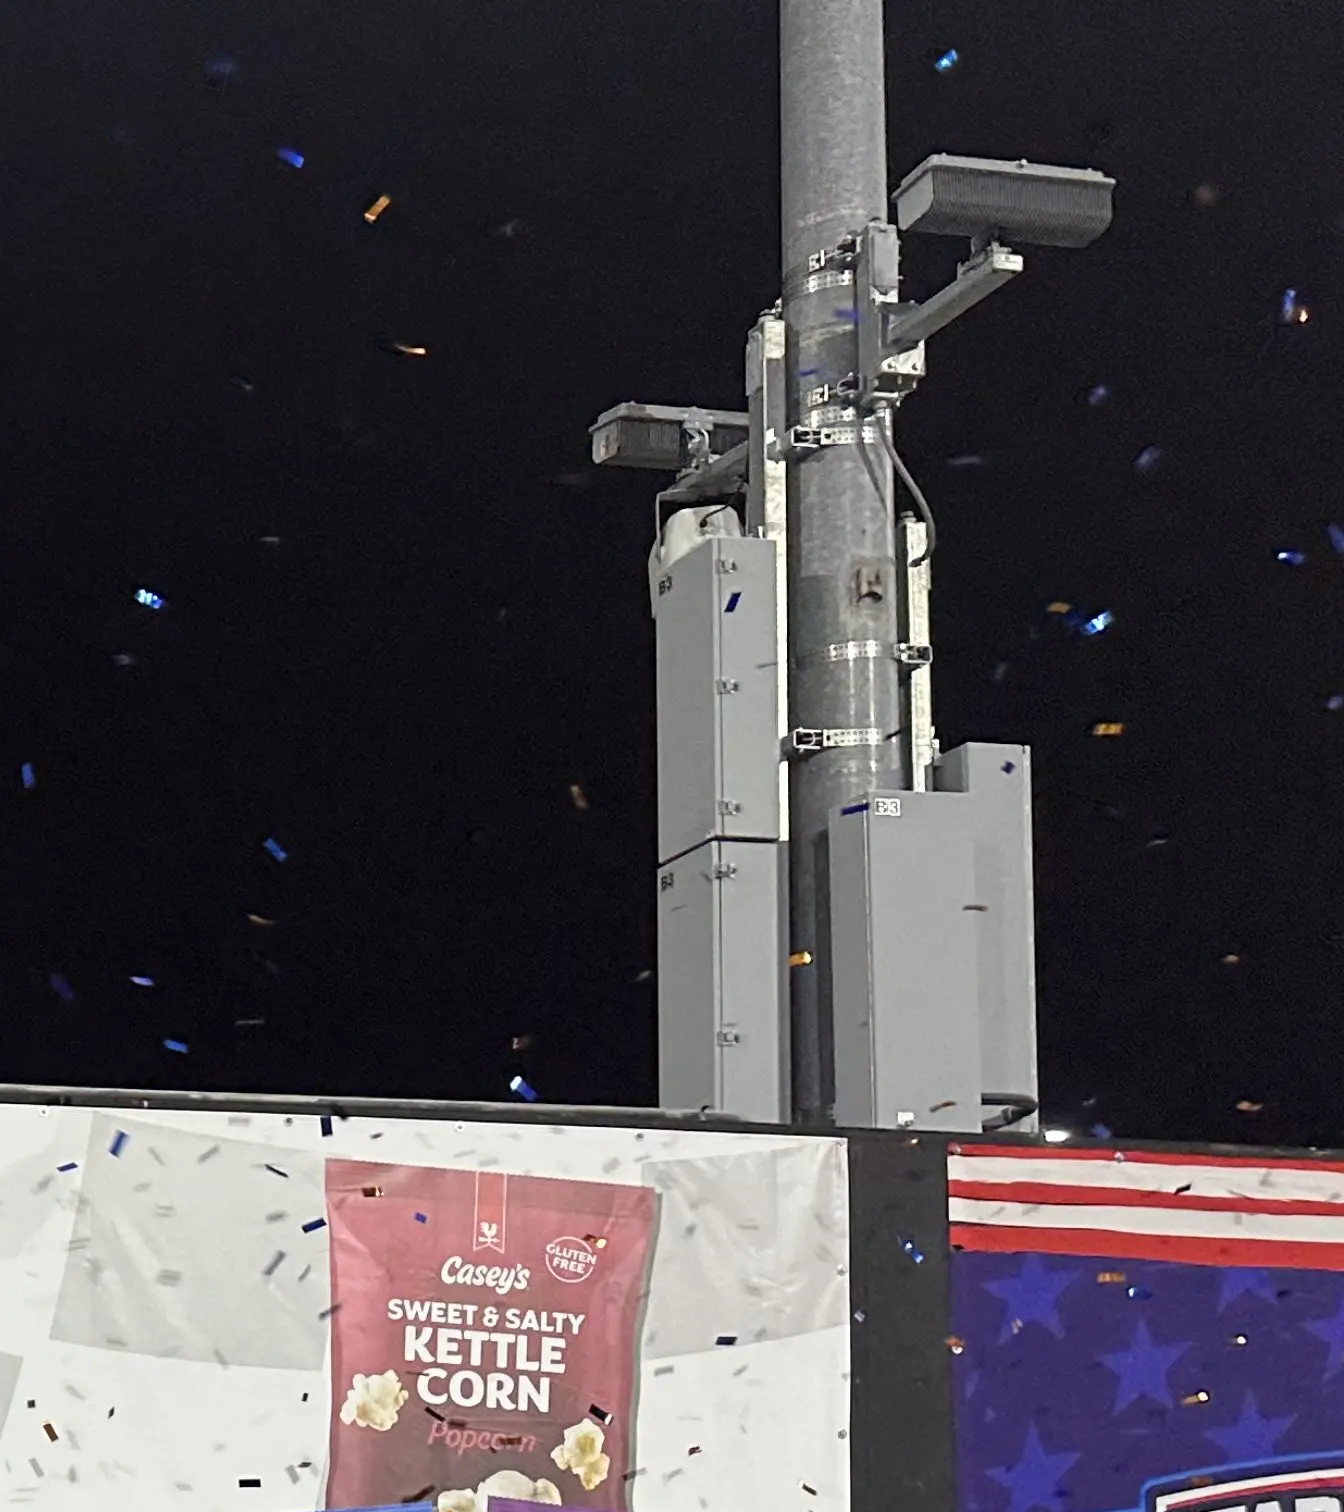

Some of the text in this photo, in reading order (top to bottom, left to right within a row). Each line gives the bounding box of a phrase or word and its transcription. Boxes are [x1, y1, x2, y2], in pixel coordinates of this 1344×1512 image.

[545, 1242, 597, 1266] GLUTEN
[552, 1257, 587, 1275] FREE
[440, 1256, 531, 1296] Casey's
[387, 1298, 585, 1335] SWEET & SALTY
[404, 1326, 567, 1374] KETTLE
[415, 1368, 552, 1413] CORN
